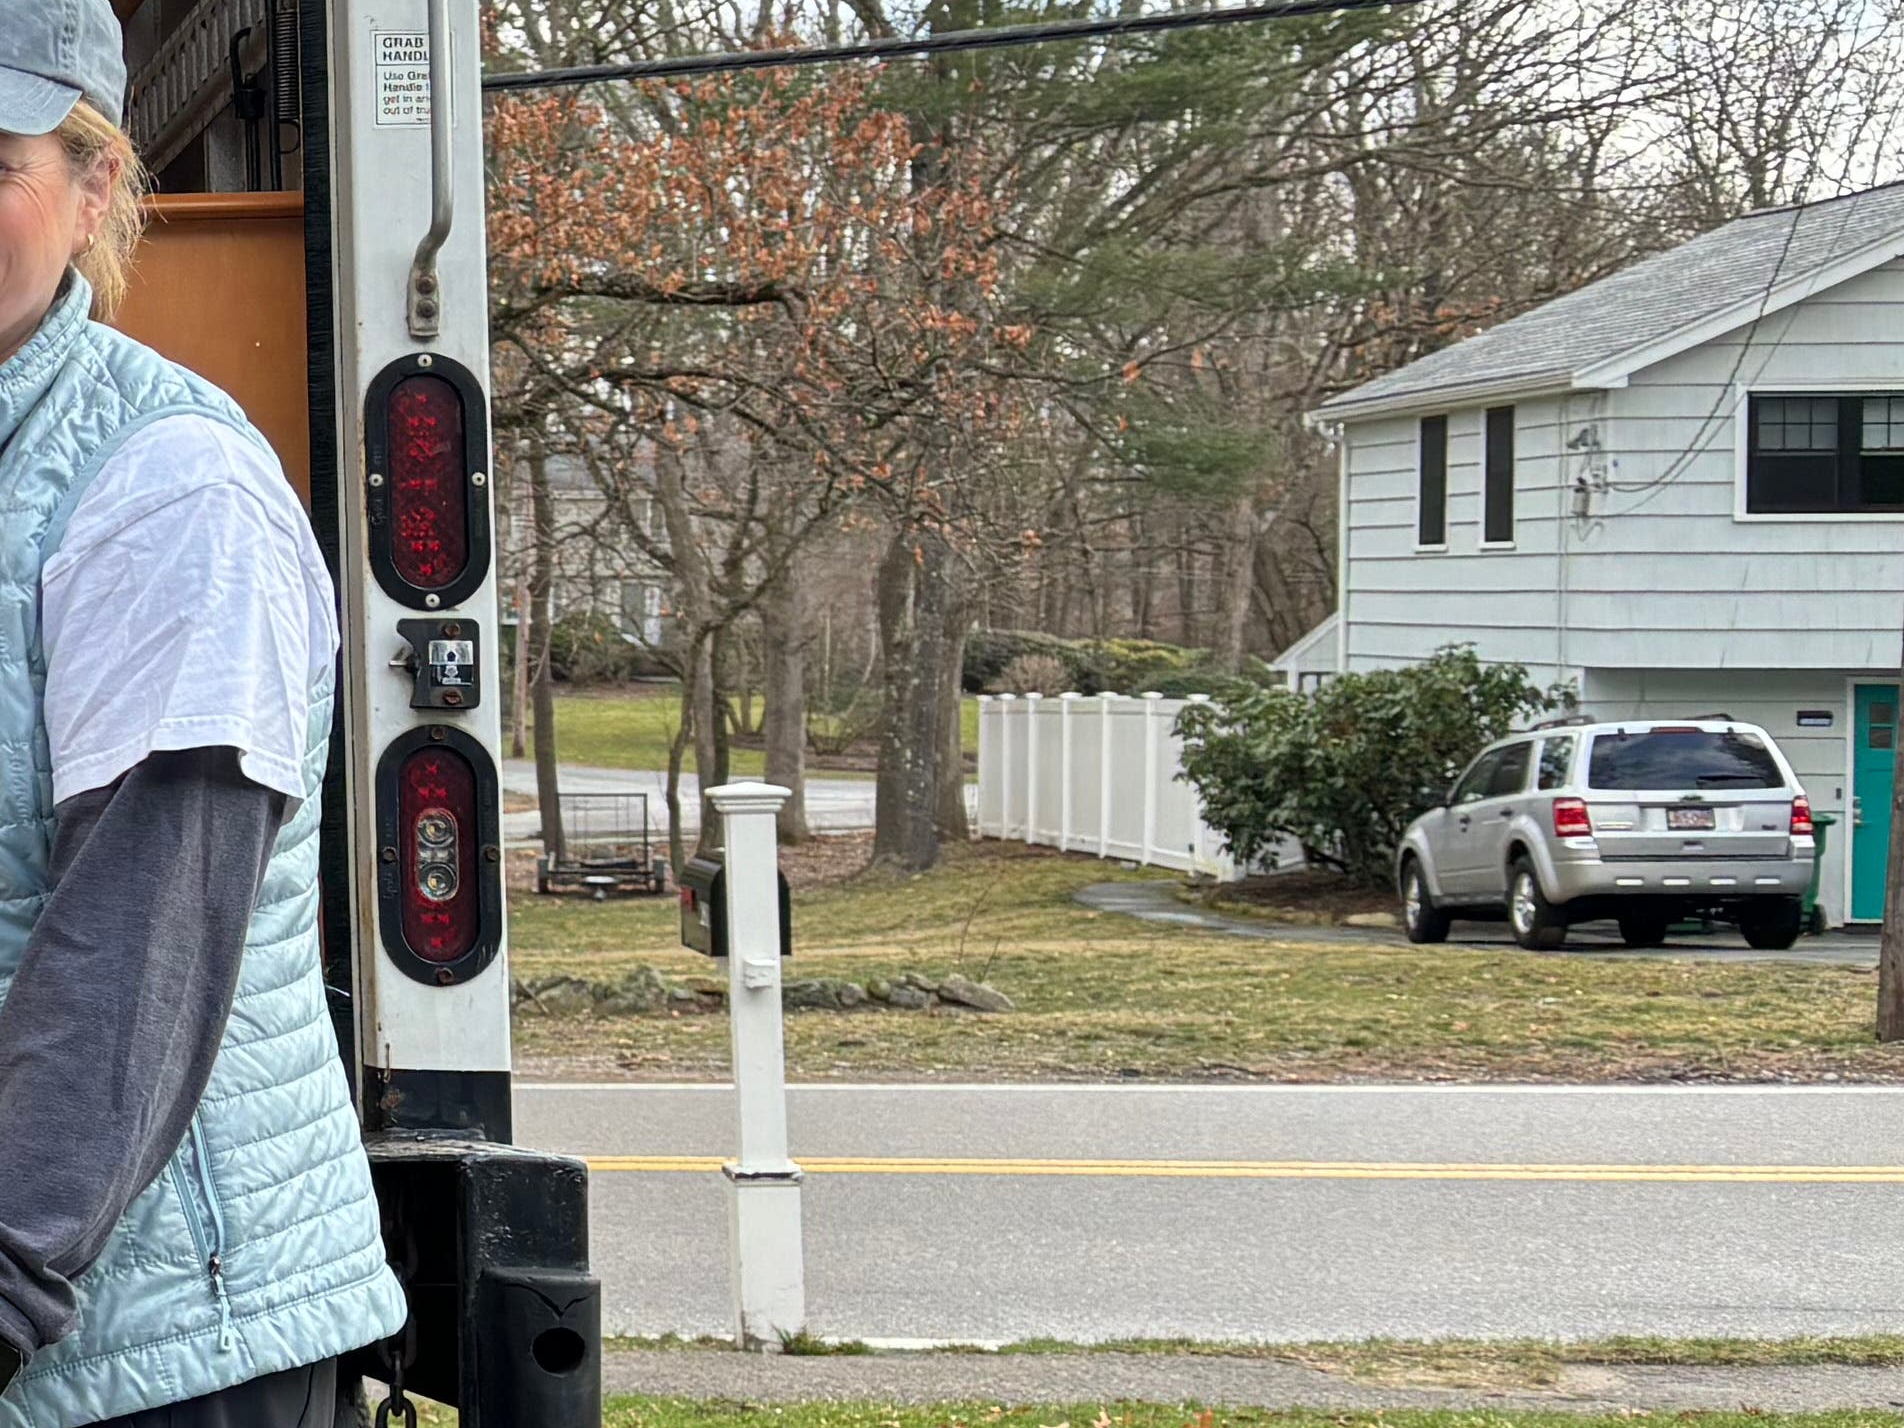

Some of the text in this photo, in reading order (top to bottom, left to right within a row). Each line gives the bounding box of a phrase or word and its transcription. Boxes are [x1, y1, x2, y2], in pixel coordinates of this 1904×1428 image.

[382, 37, 424, 49] GRAB
[382, 51, 429, 62] HANDL
[383, 71, 429, 81] Use Gra
[383, 83, 423, 93] Handle
[382, 95, 401, 106] get
[403, 95, 413, 103] in
[382, 106, 431, 115] out of tru
